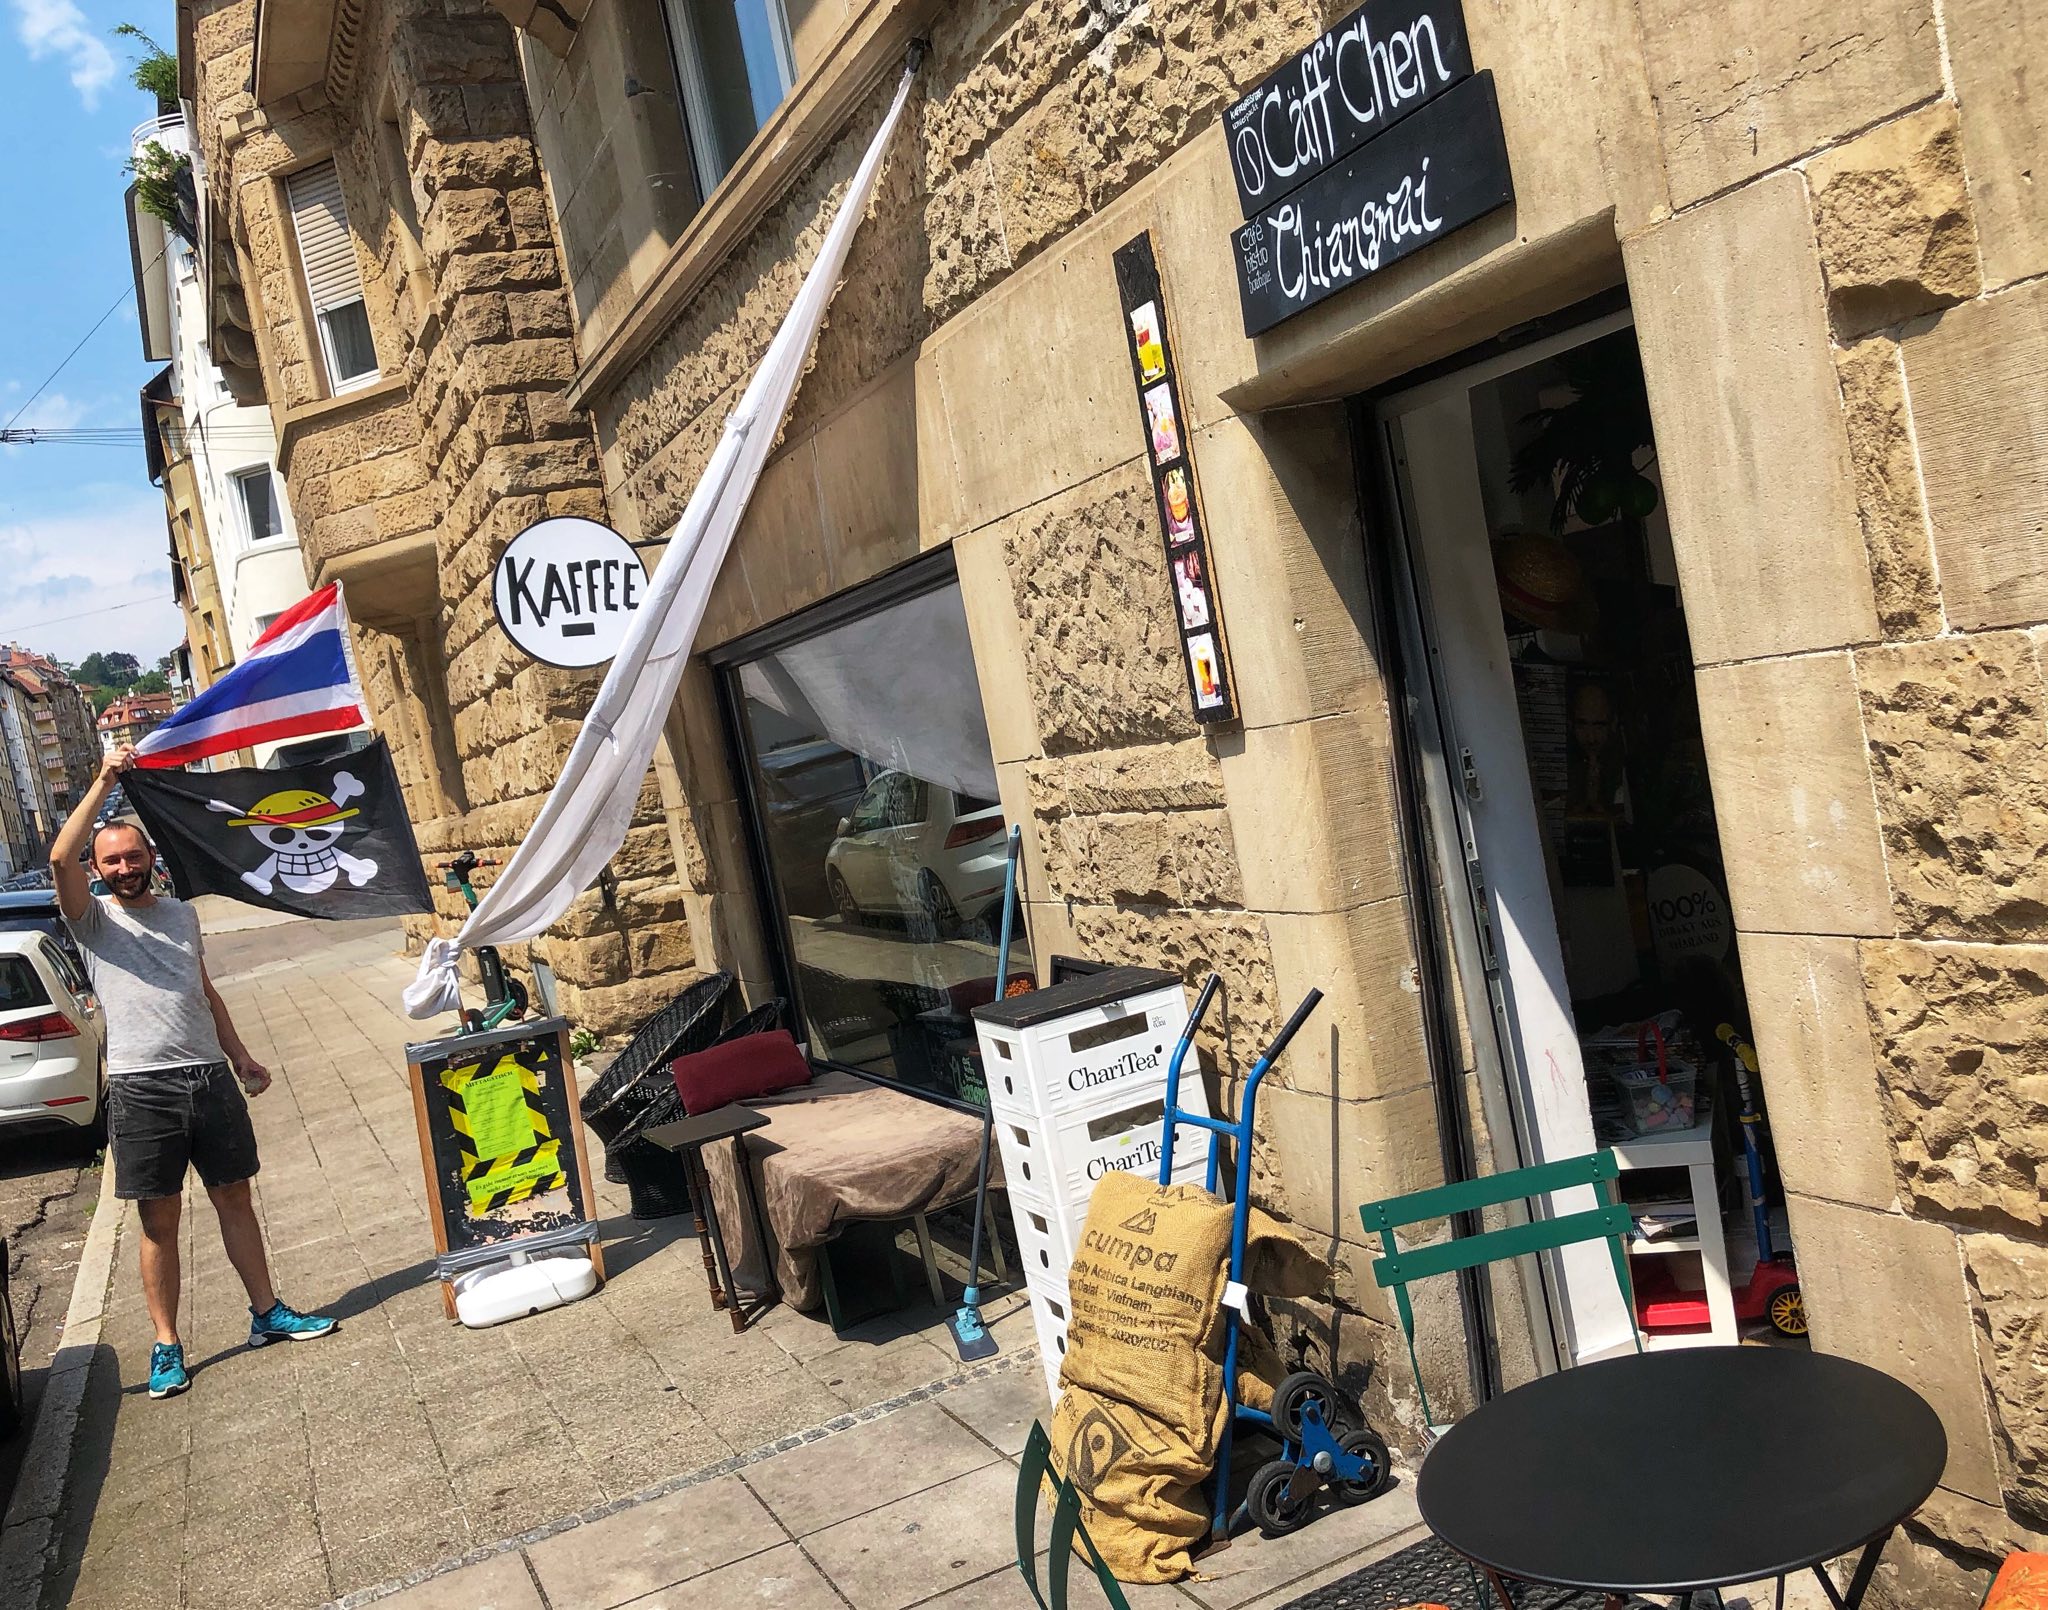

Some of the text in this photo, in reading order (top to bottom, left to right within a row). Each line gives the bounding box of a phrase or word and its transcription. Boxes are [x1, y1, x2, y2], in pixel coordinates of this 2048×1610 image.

[1267, 157, 1443, 301] Chiangmai
[504, 556, 640, 628] KAFFEE
[1650, 889, 1716, 924] 100%
[1067, 1051, 1160, 1092] ChariTea
[1084, 1230, 1178, 1273] cumpa
[1107, 1288, 1152, 1314] Vietnam
[1130, 1277, 1204, 1315] Langbiang
